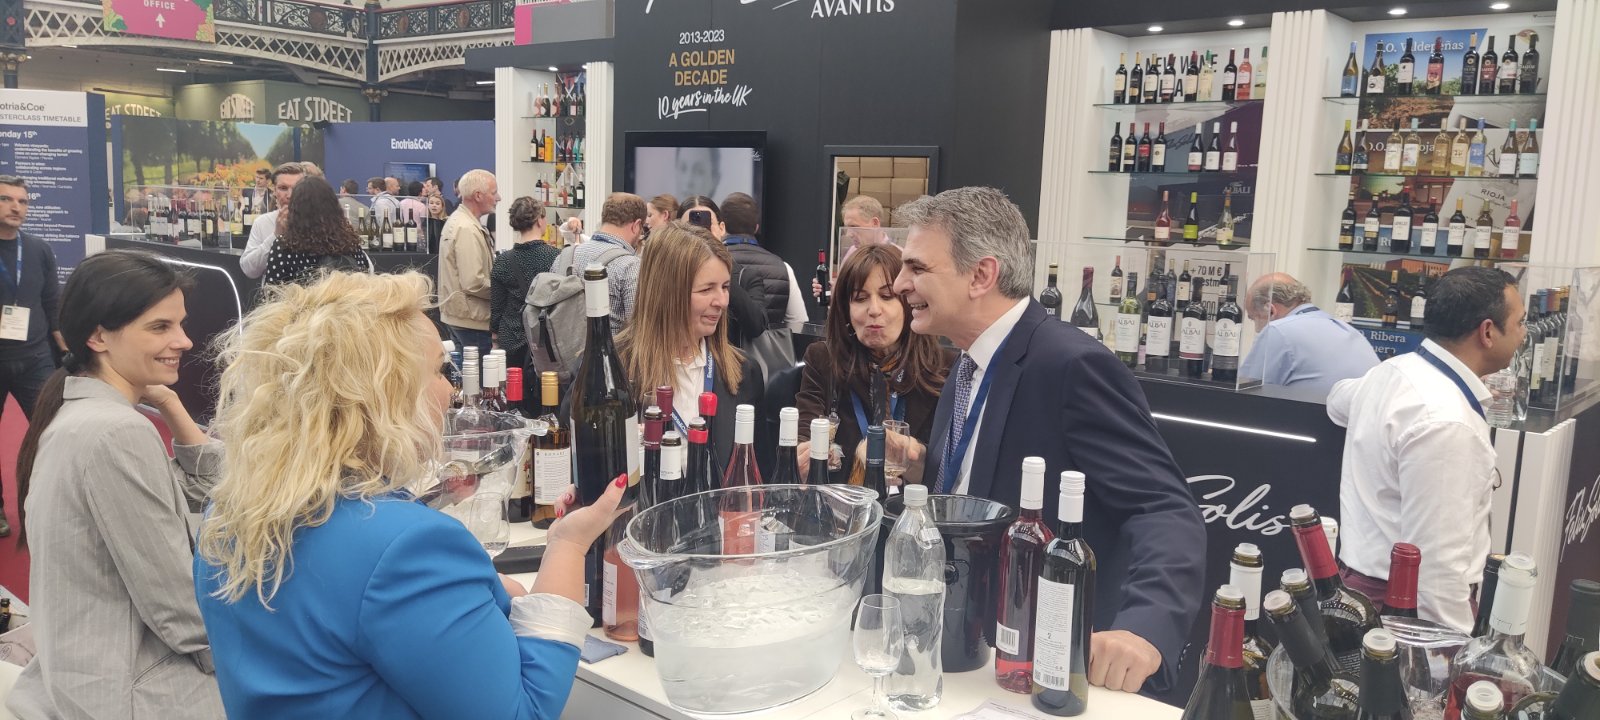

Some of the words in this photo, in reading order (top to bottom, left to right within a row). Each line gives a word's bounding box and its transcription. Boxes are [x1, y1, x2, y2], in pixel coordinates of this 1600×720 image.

[144, 0, 176, 10] OFFICE
[811, 0, 895, 18] AVANTIS
[679, 29, 725, 44] 2013-2023
[668, 52, 678, 67] A
[680, 49, 735, 67] GOLDEN
[674, 69, 728, 86] DECADE
[0, 102, 45, 111] otria&Coe
[658, 96, 670, 120] 10
[672, 90, 701, 120] years
[702, 92, 714, 104] in
[714, 87, 732, 104] the
[732, 84, 752, 106] UK
[278, 98, 301, 120] EAT
[304, 96, 352, 123] STREET
[0, 130, 21, 139] onday
[391, 138, 433, 150] Enotria&Coe
[1480, 188, 1506, 201] RIOJA
[1198, 266, 1206, 276] 70
[1208, 266, 1215, 276] M
[1217, 267, 1222, 276] €
[1370, 331, 1406, 342] Ribera
